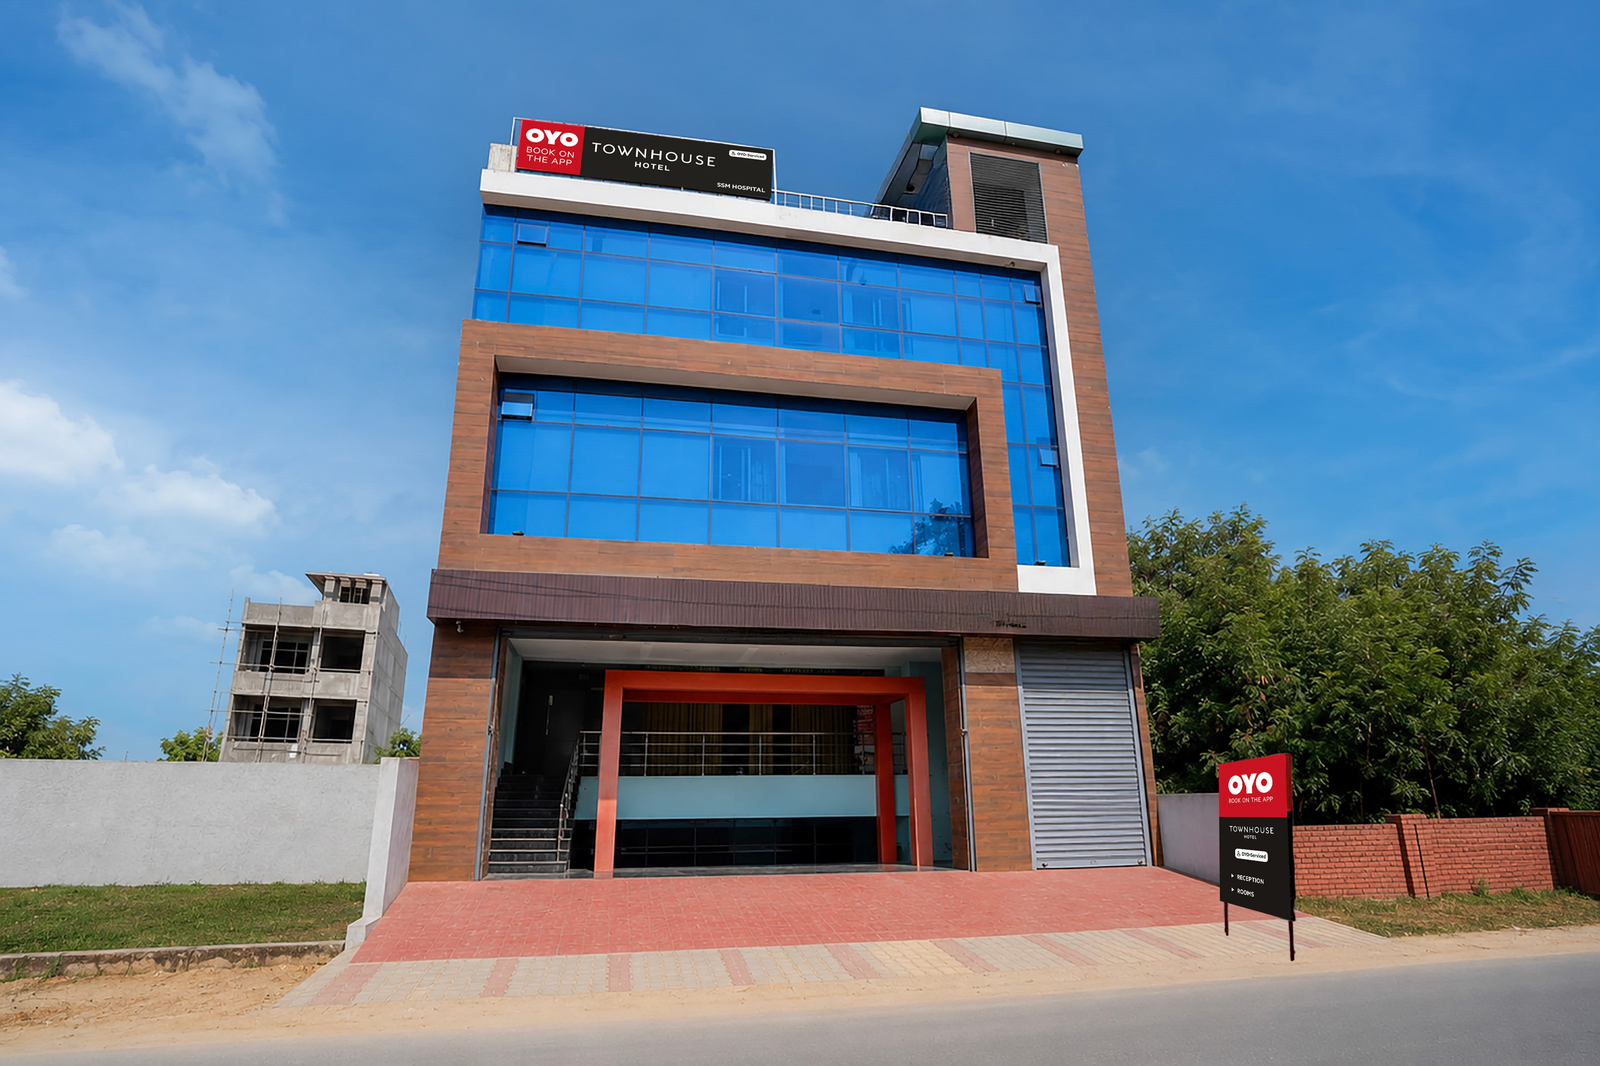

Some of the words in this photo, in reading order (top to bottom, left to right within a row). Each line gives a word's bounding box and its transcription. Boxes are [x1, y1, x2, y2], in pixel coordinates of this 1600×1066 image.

[526, 128, 579, 147] OYO
[526, 146, 556, 157] BOOK
[558, 150, 576, 159] ON
[591, 141, 716, 168] TOWNHOUSE
[526, 155, 550, 165] THE
[551, 157, 573, 167] APP
[634, 161, 671, 172] HOTEL
[717, 182, 731, 190] SSM
[732, 184, 766, 193] HOSPITAL
[1228, 772, 1273, 795] OYO
[1229, 825, 1274, 834] TOWNHOUSE
[1237, 874, 1264, 884] RECEPTION
[1237, 888, 1254, 898] ROOMS
